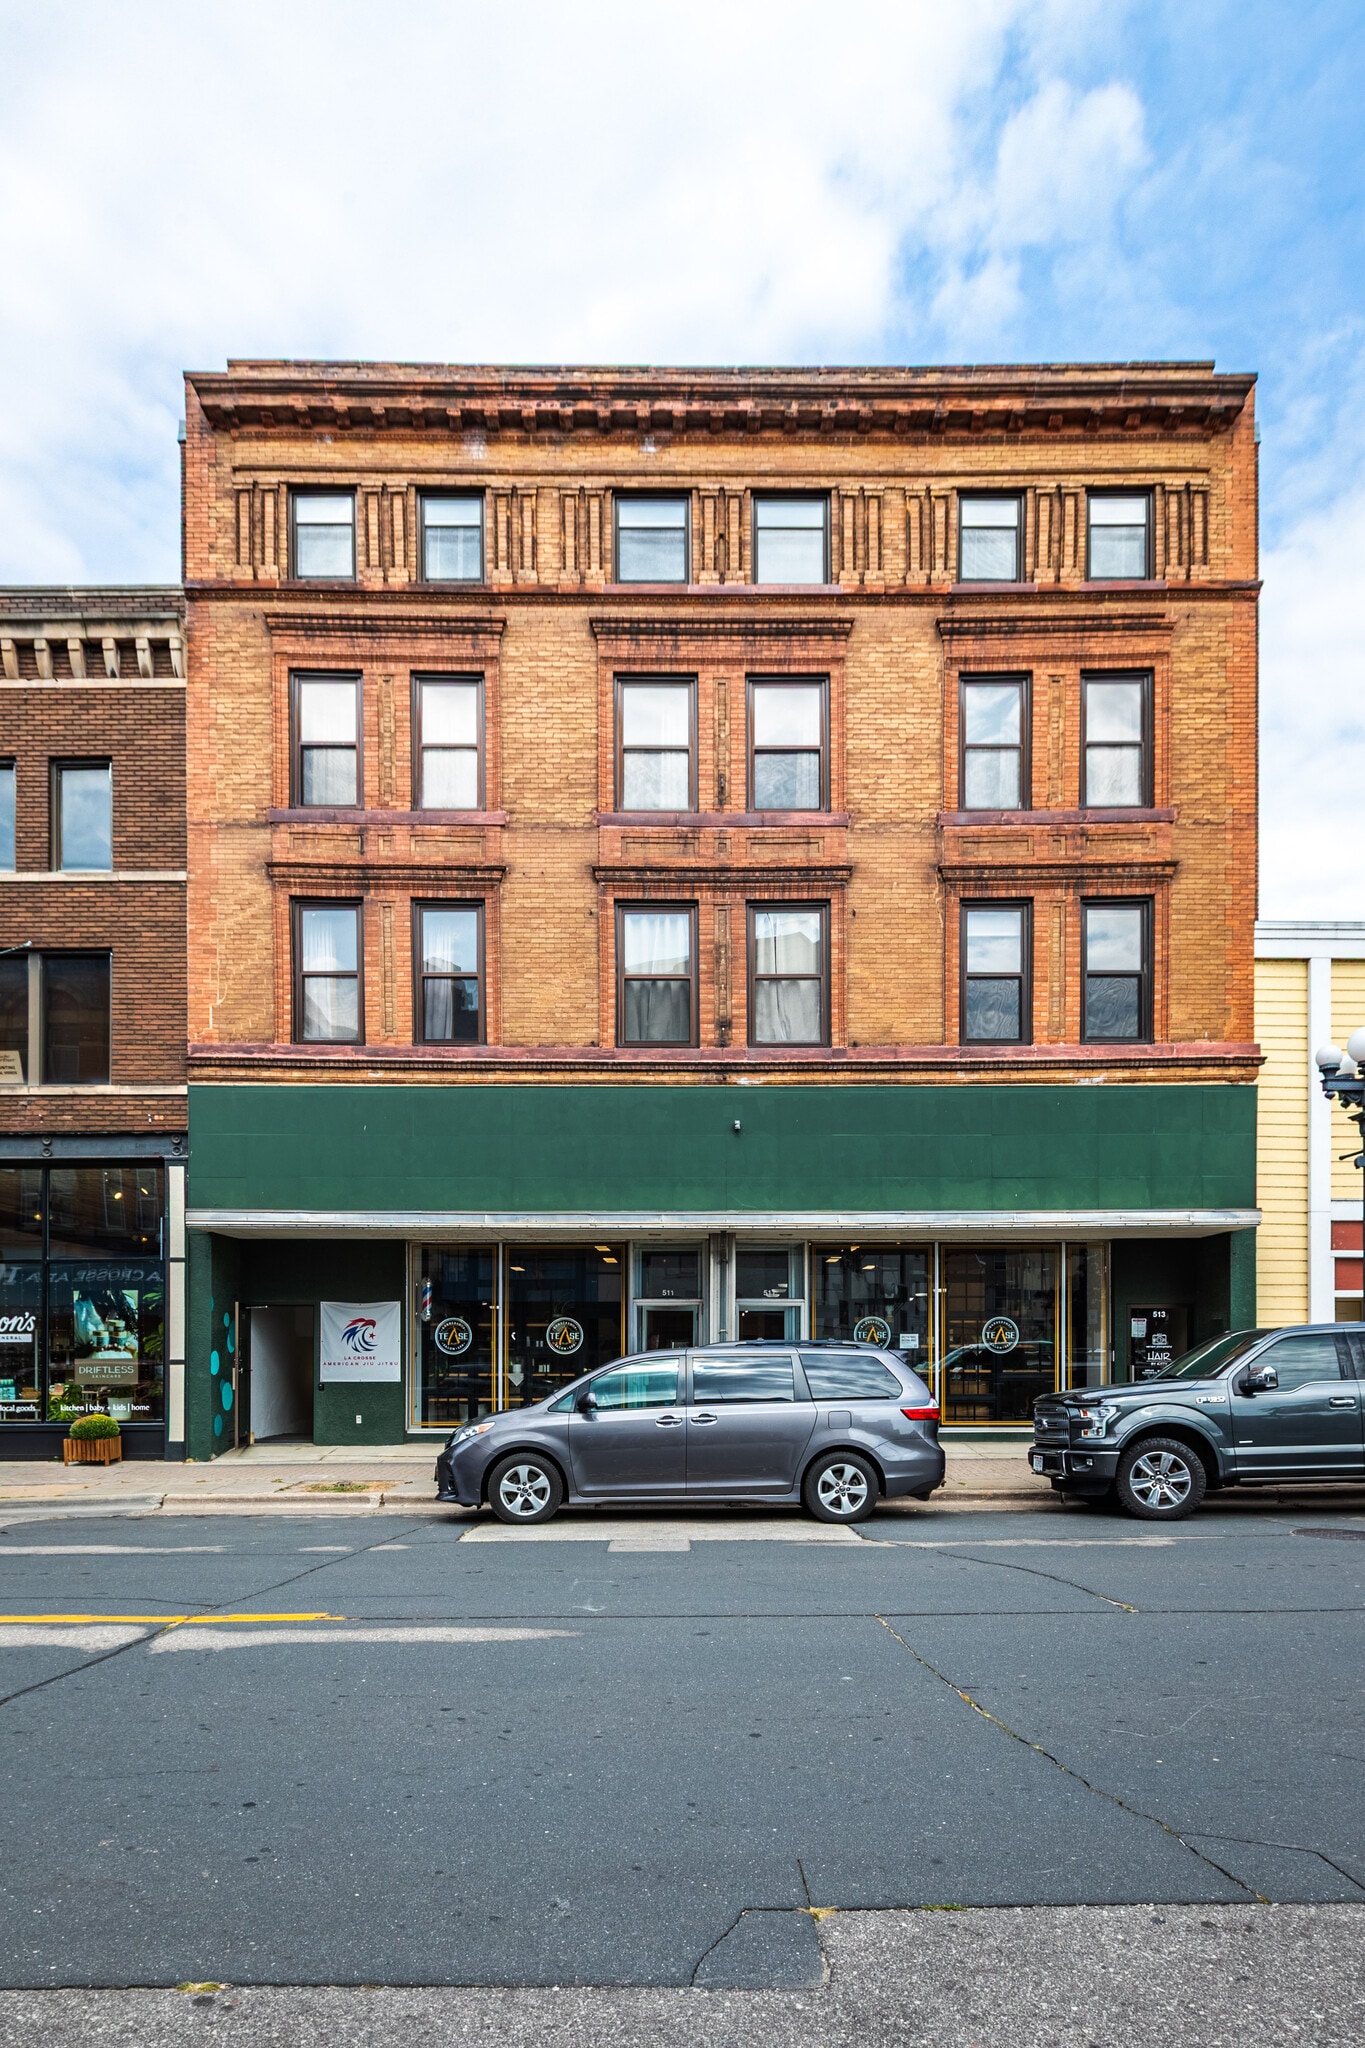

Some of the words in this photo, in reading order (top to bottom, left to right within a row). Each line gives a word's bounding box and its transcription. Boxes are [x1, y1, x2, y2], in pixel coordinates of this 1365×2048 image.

[439, 1327, 469, 1345] TEASE
[550, 1327, 580, 1345] TEASE
[858, 1326, 887, 1343] TEASE
[986, 1326, 1016, 1344] TEASE
[1147, 1351, 1171, 1361] HAIR
[79, 1366, 134, 1374] DRIFTLESS
[0, 1404, 15, 1412] local
[16, 1404, 36, 1413] goods
[89, 1403, 105, 1413] baby
[112, 1403, 127, 1411] kids
[131, 1403, 150, 1411] home
